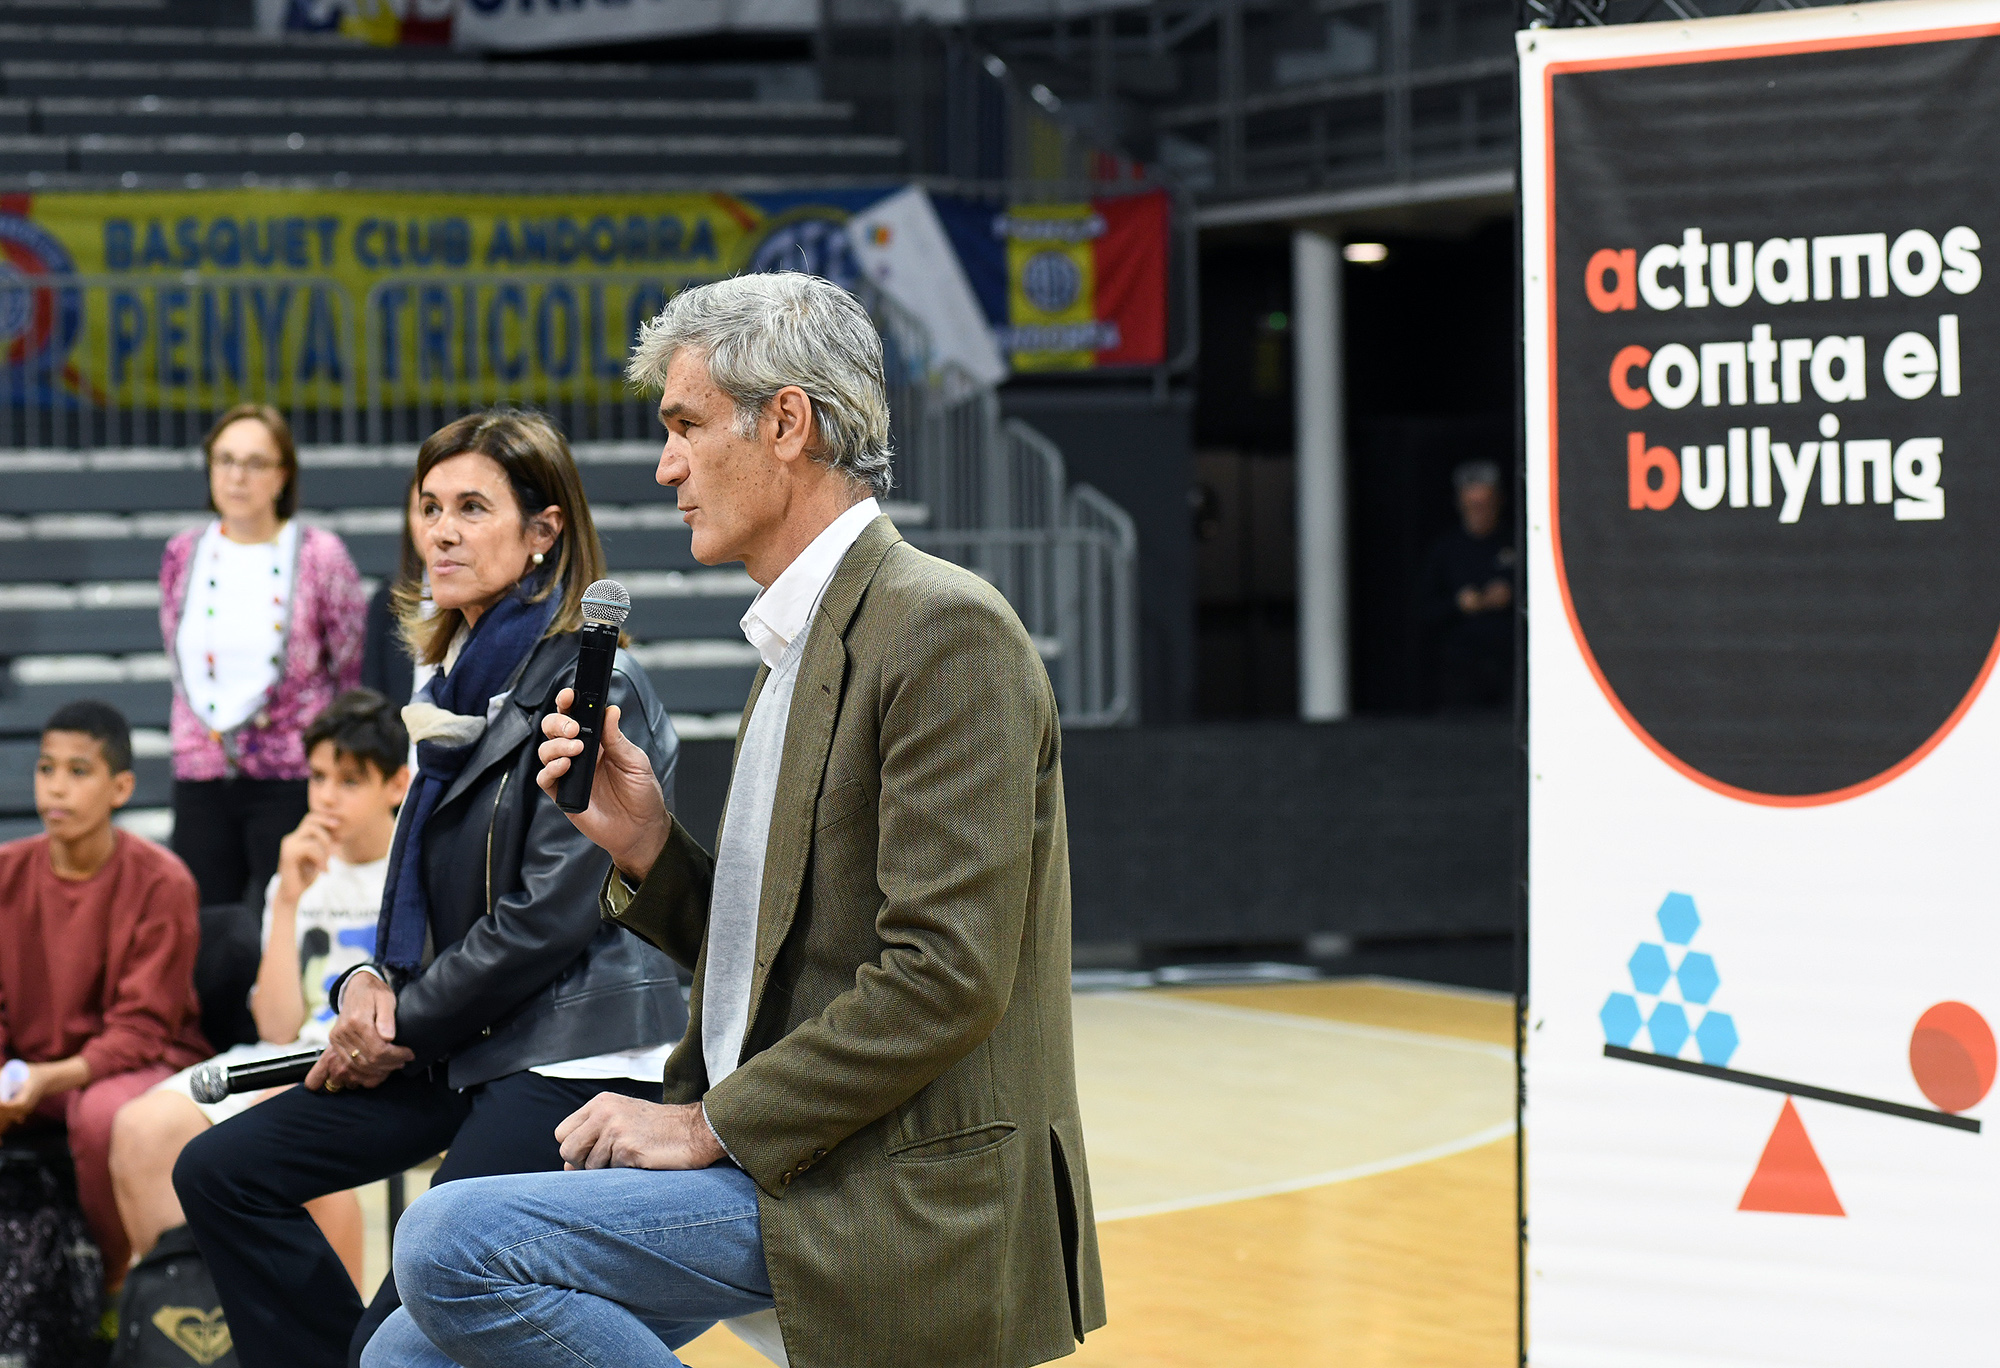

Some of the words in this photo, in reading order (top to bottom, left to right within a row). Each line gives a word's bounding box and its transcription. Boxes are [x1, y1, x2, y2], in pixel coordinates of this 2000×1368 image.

[105, 216, 339, 269] BASQUET
[354, 216, 470, 269] CLUB
[487, 214, 718, 266] ANDORRA
[1585, 226, 1982, 313] actuamos
[109, 282, 344, 387] PENYA
[1609, 324, 1866, 410] contra
[1883, 314, 1961, 400] el
[1628, 413, 1945, 524] bullying
